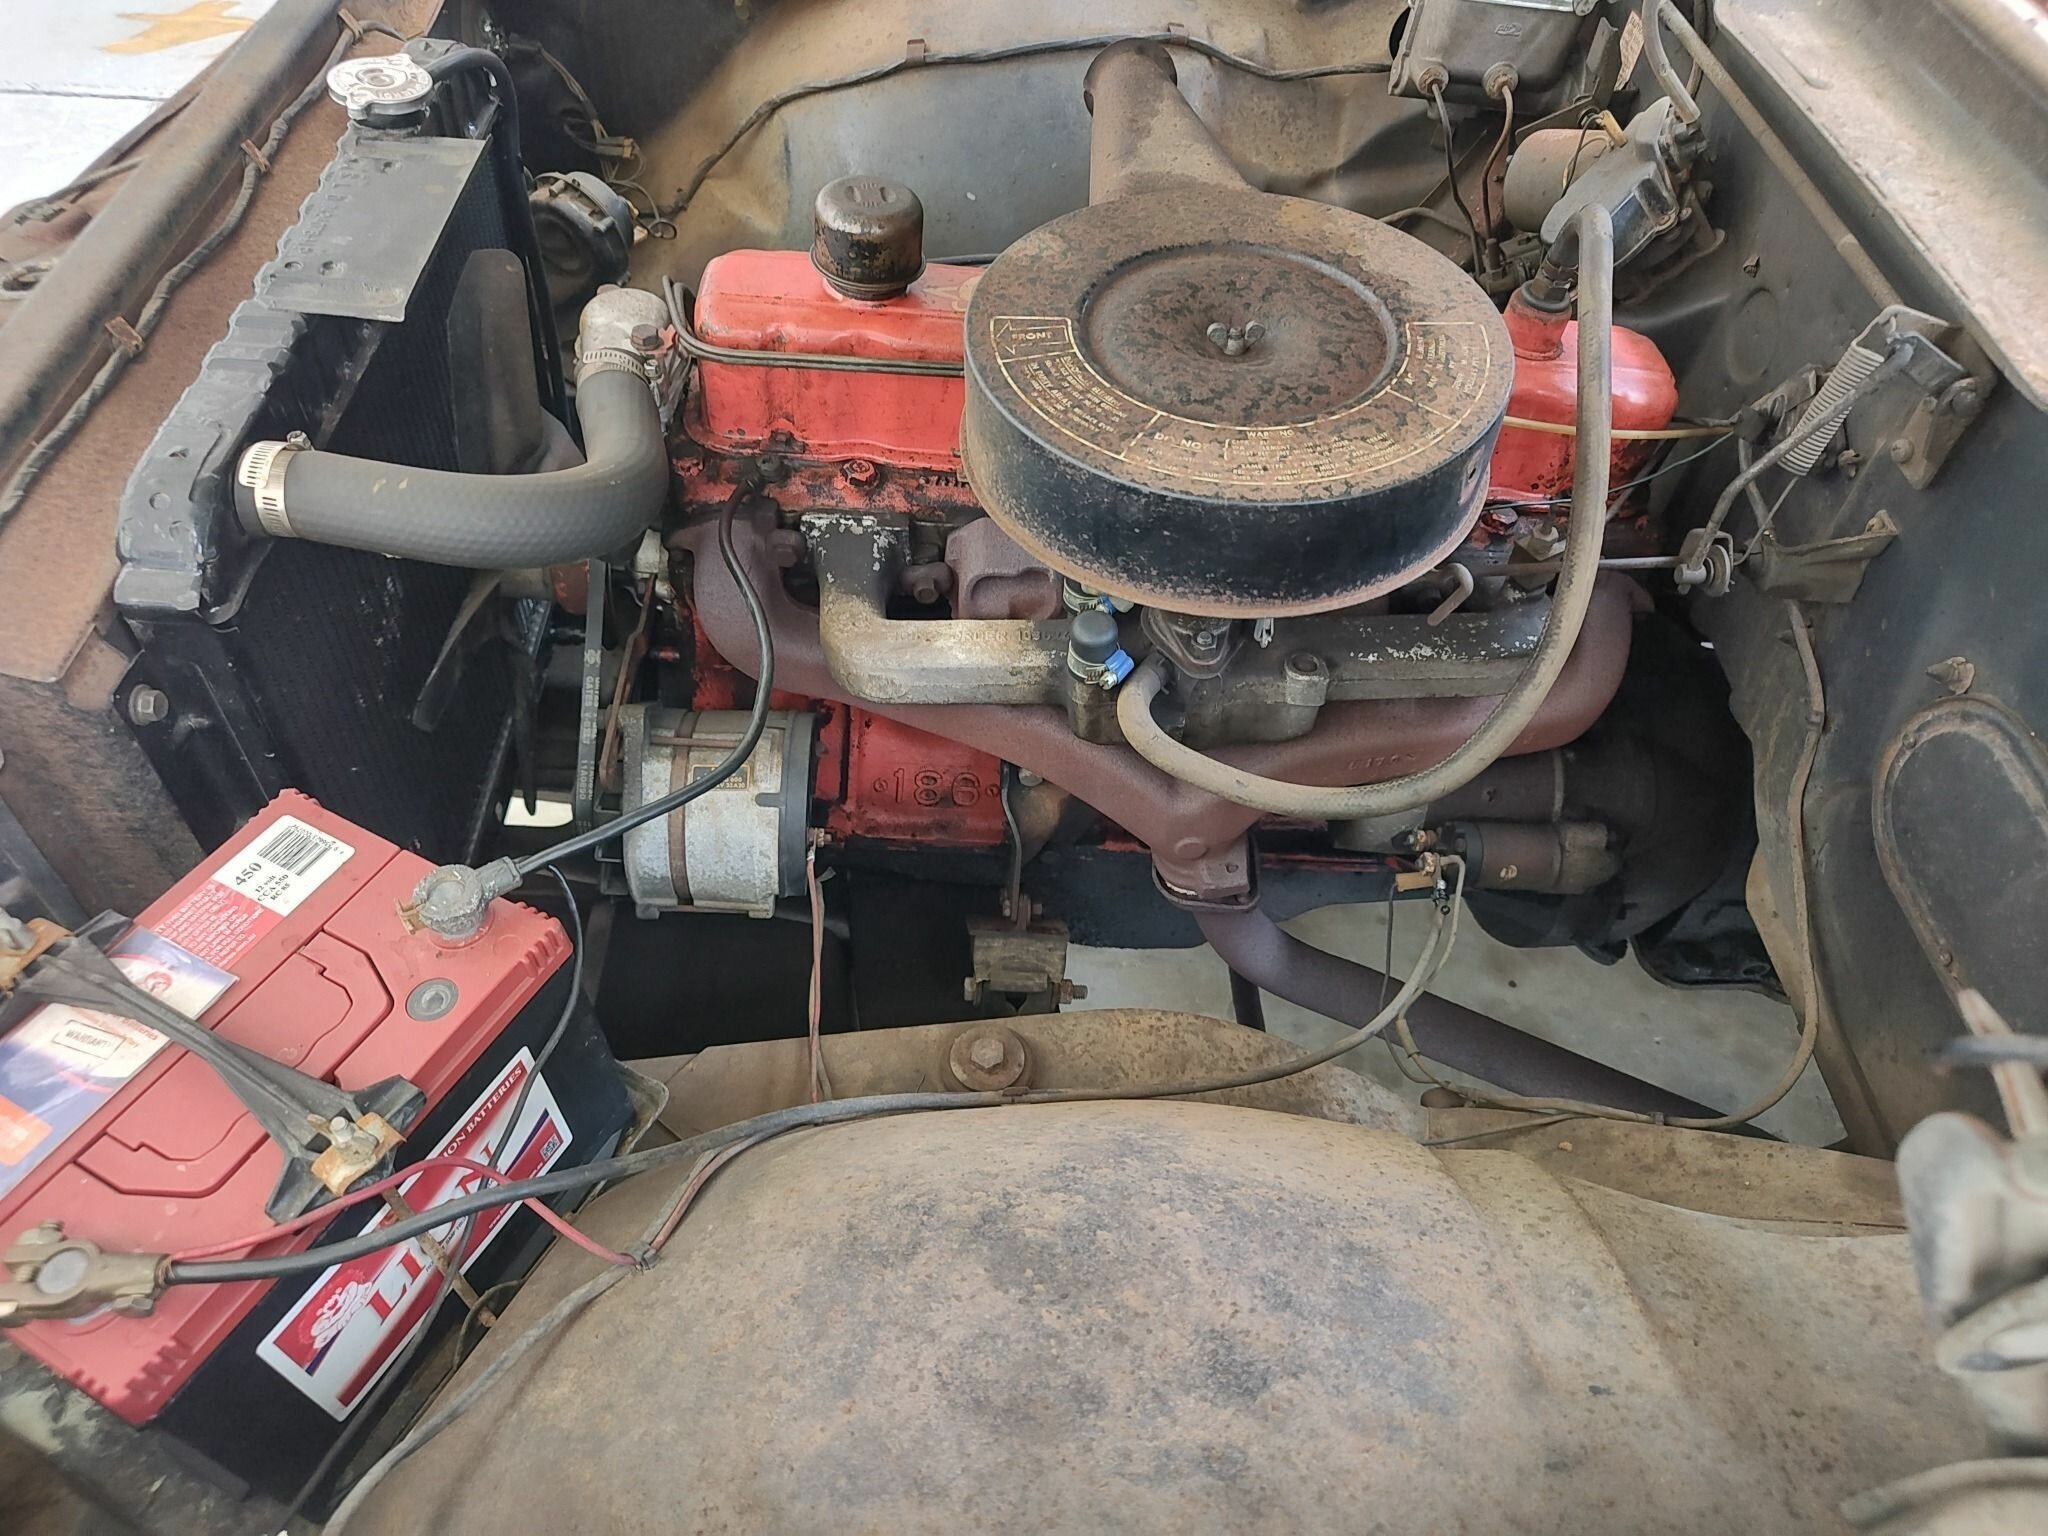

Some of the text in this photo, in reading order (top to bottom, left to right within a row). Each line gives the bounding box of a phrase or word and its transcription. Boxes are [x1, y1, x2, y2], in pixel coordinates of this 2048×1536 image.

[1011, 331, 1053, 341] FRONT
[1246, 429, 1293, 438] WARNG
[586, 676, 594, 706] GATES
[893, 767, 980, 806] 186
[232, 860, 263, 886] 450
[254, 883, 265, 892] 12
[256, 885, 276, 902] CCA
[269, 890, 282, 900] RC
[466, 1066, 523, 1132] BATTERIES
[366, 1140, 503, 1326] LIN
